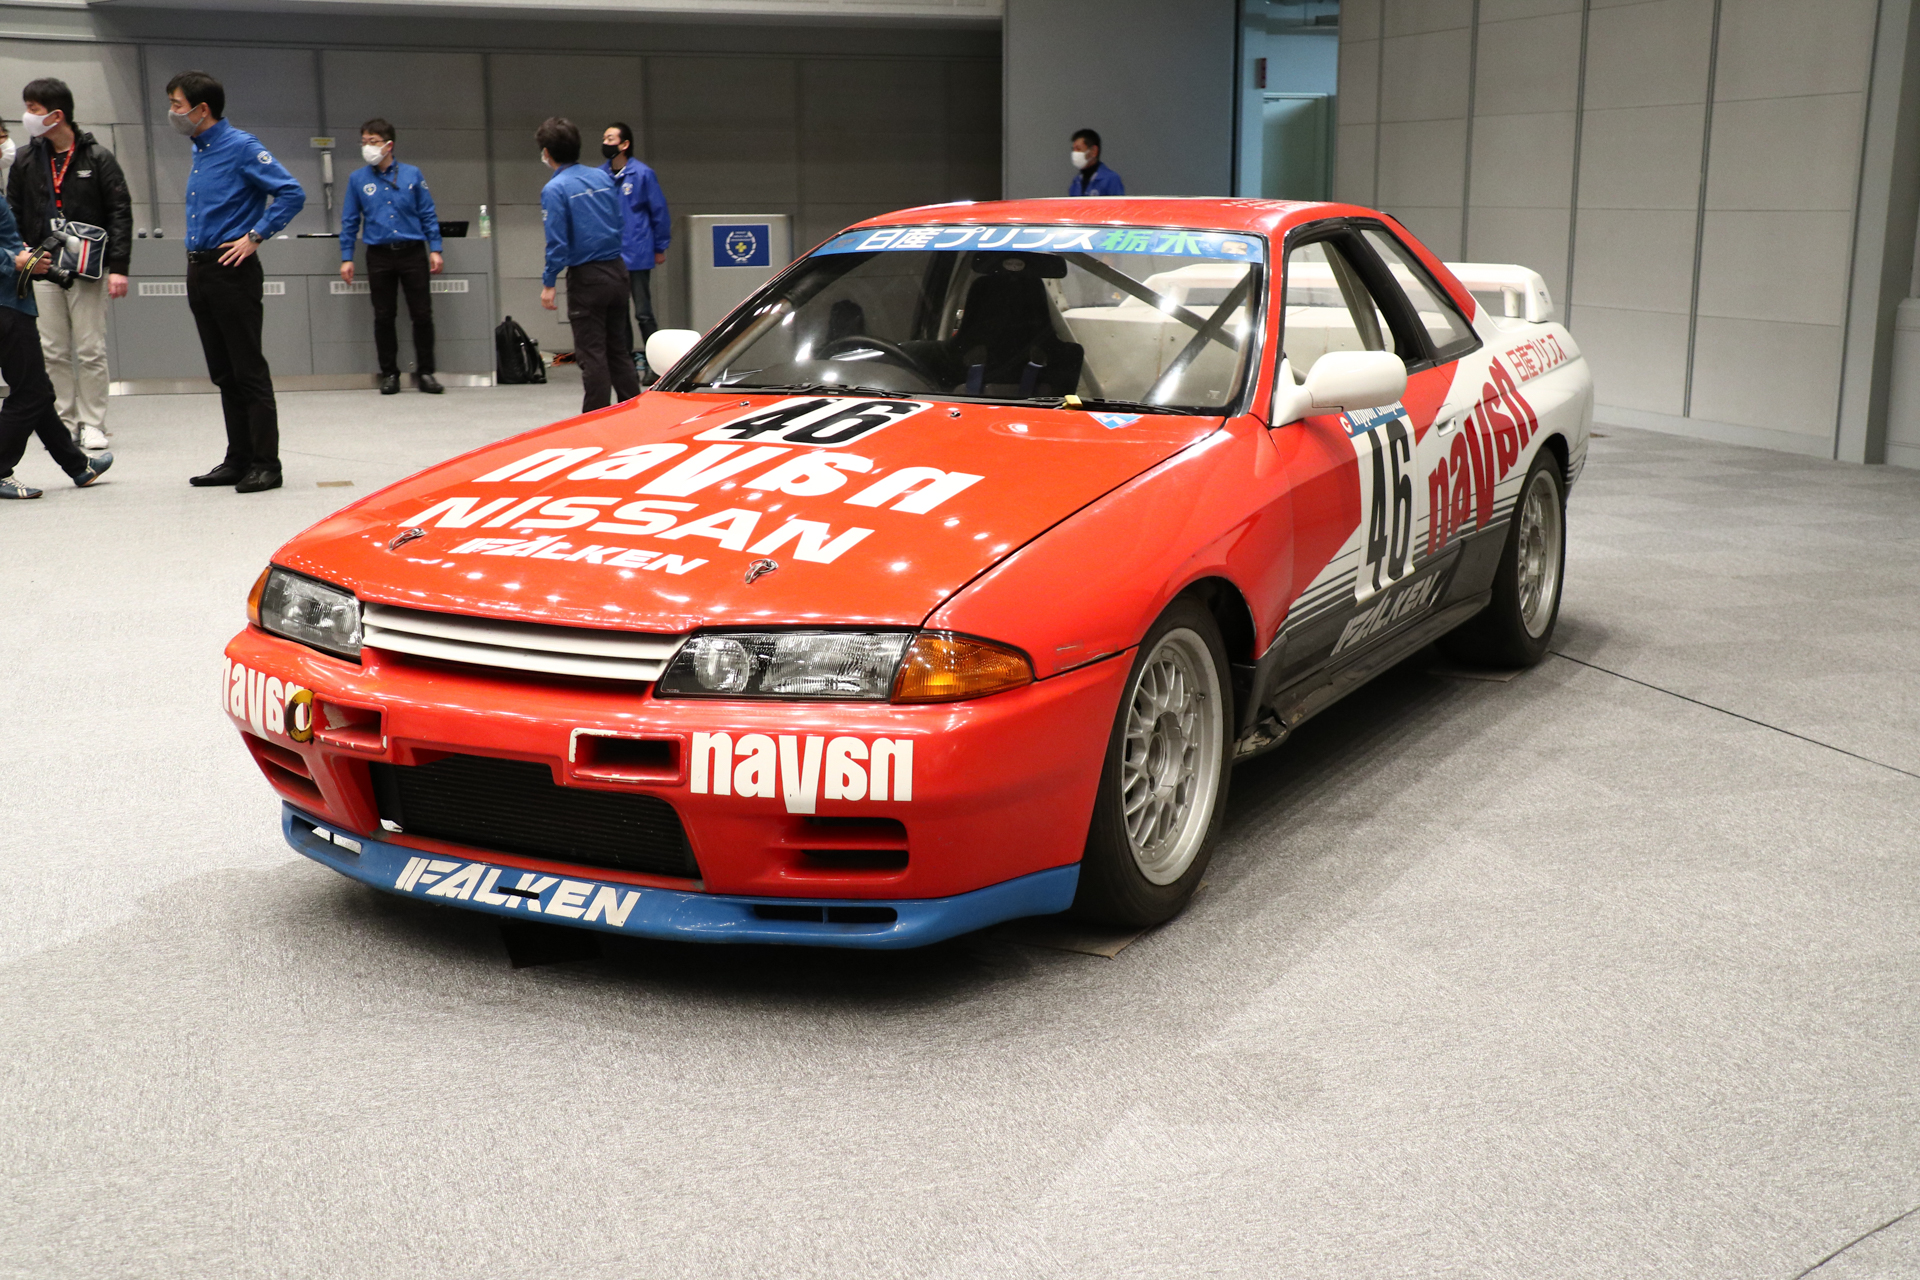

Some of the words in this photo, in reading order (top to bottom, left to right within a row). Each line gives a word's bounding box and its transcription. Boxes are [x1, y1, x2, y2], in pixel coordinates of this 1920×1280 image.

[721, 398, 922, 444] 46
[397, 496, 876, 565] NISSAN
[1366, 417, 1412, 592] 46
[448, 534, 710, 575] FALKEN
[1330, 570, 1441, 657] FALKEN
[395, 856, 641, 928] FALKEN
